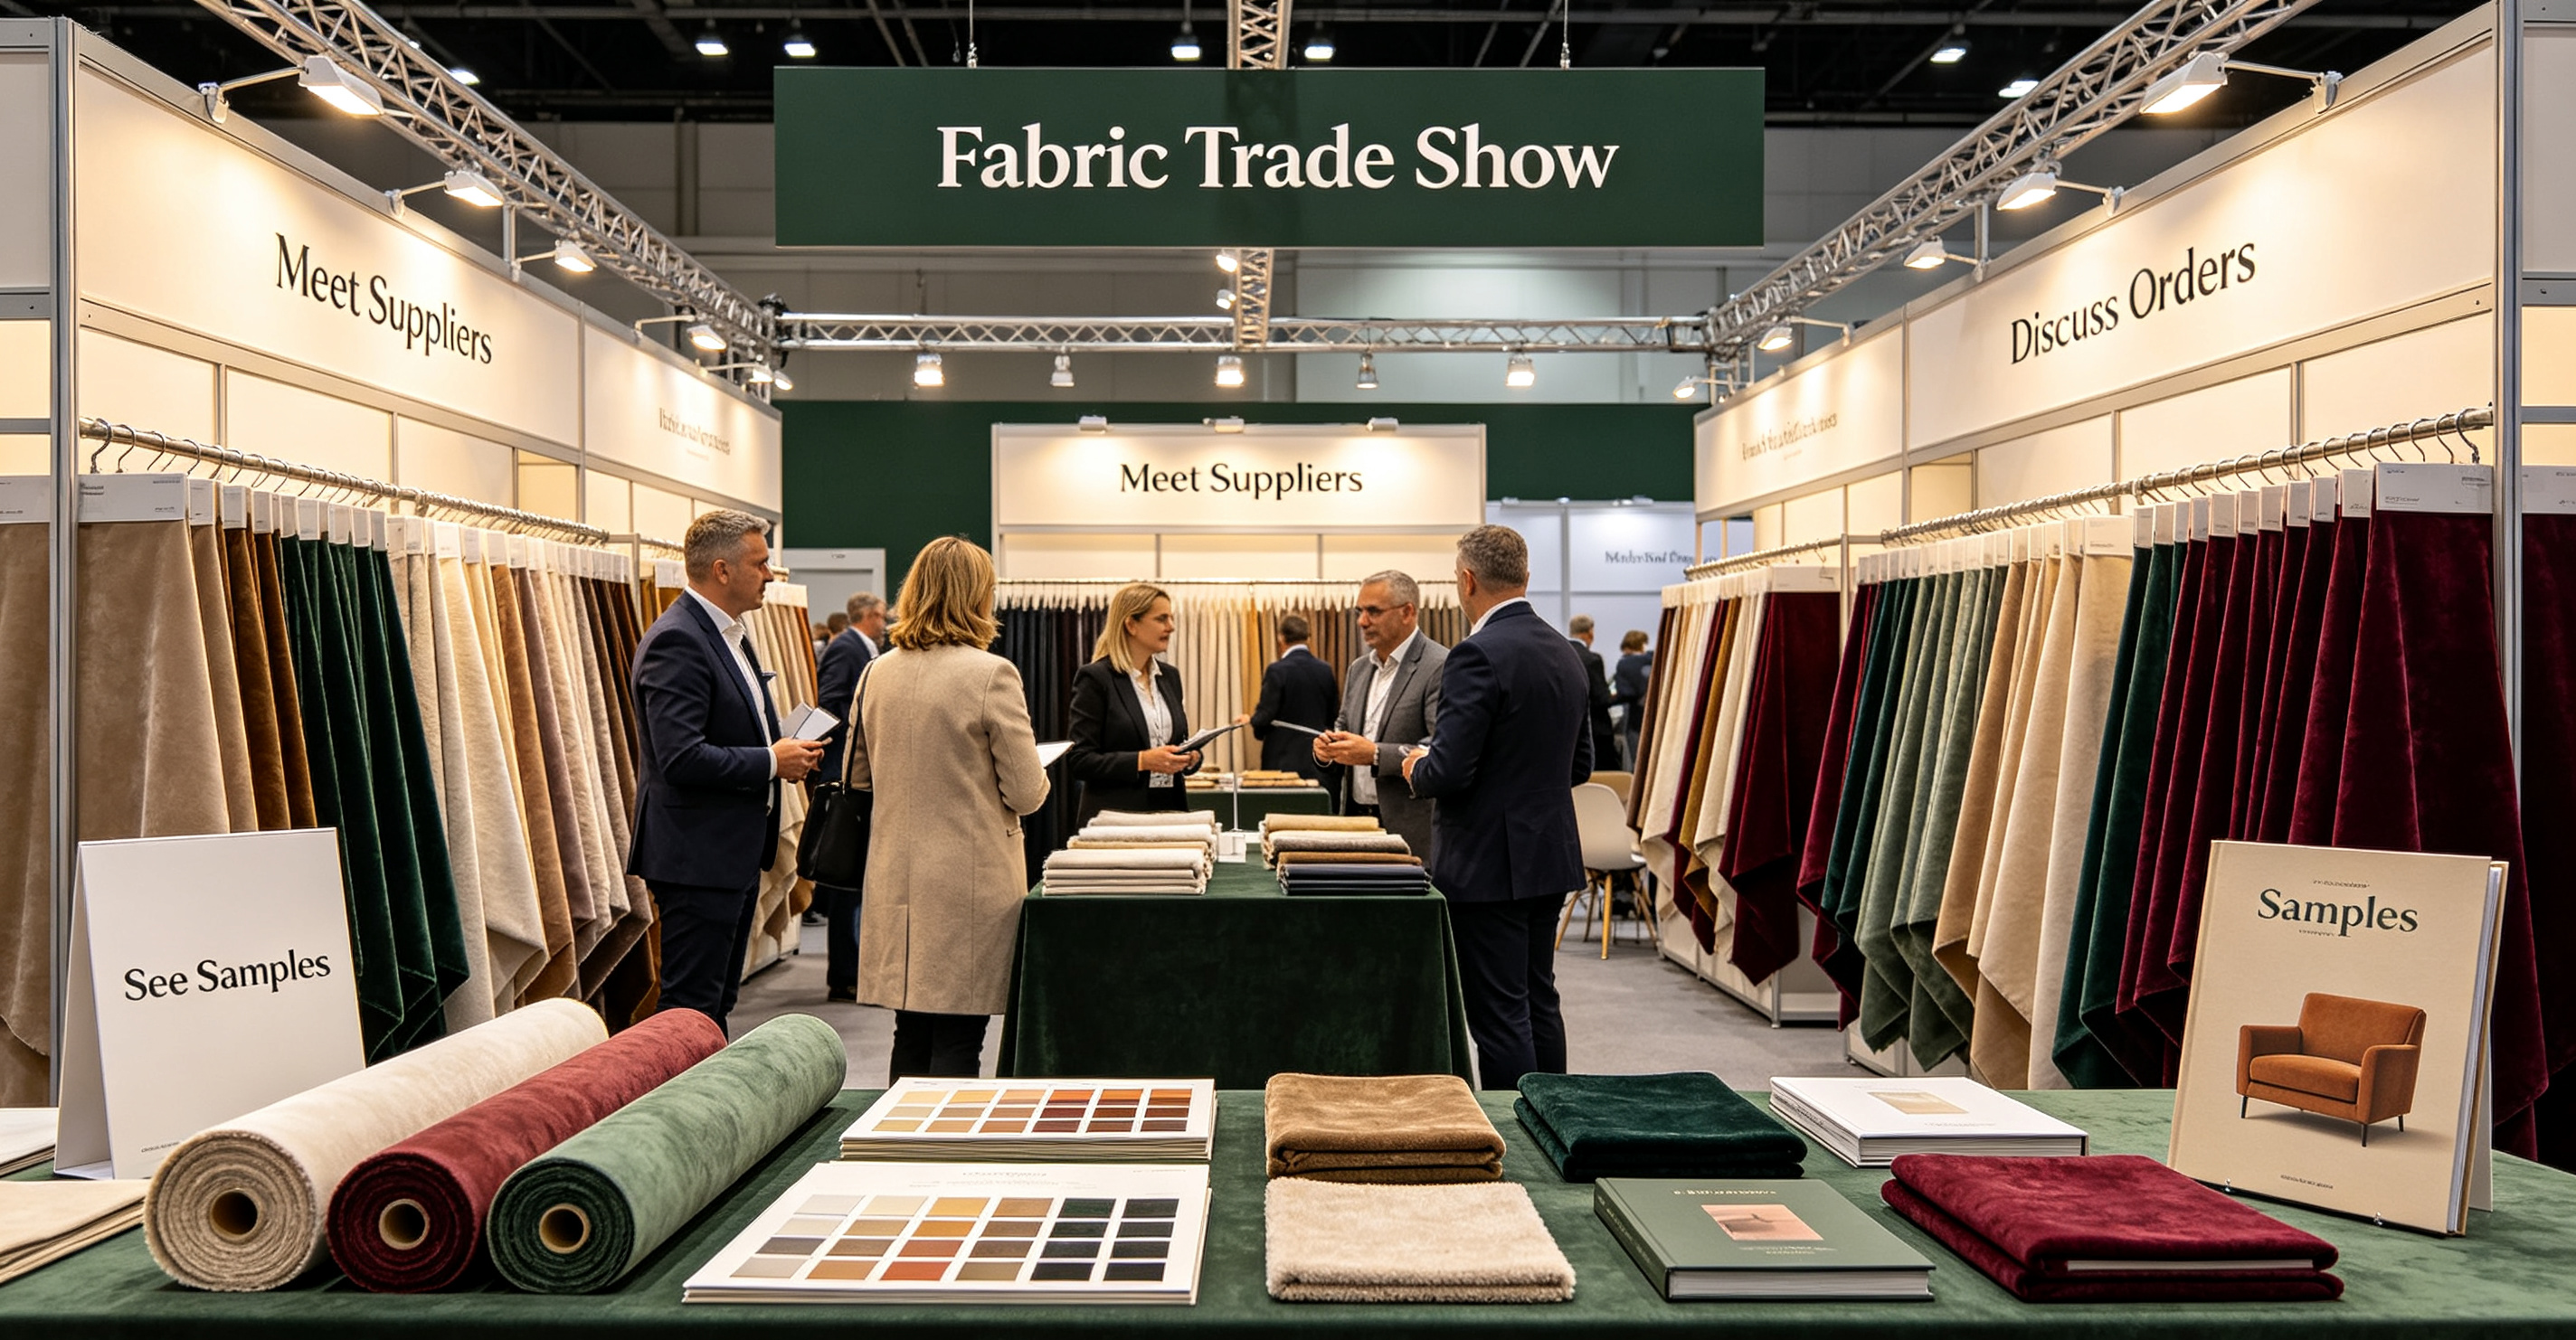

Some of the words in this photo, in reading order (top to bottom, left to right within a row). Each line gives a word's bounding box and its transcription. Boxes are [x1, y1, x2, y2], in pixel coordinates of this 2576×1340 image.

[936, 122, 1170, 189] Fabric
[1184, 122, 1395, 189] Trade
[1416, 122, 1620, 190] Show
[275, 232, 361, 317] Meet
[368, 274, 493, 364] Suppliers
[2011, 295, 2119, 364] Discuss
[2128, 242, 2256, 319] Orders
[1121, 463, 1200, 493] Meet
[1209, 462, 1363, 501] Suppliers
[2258, 888, 2419, 938] Samples
[124, 967, 188, 1001] See
[196, 948, 331, 993] Samples
